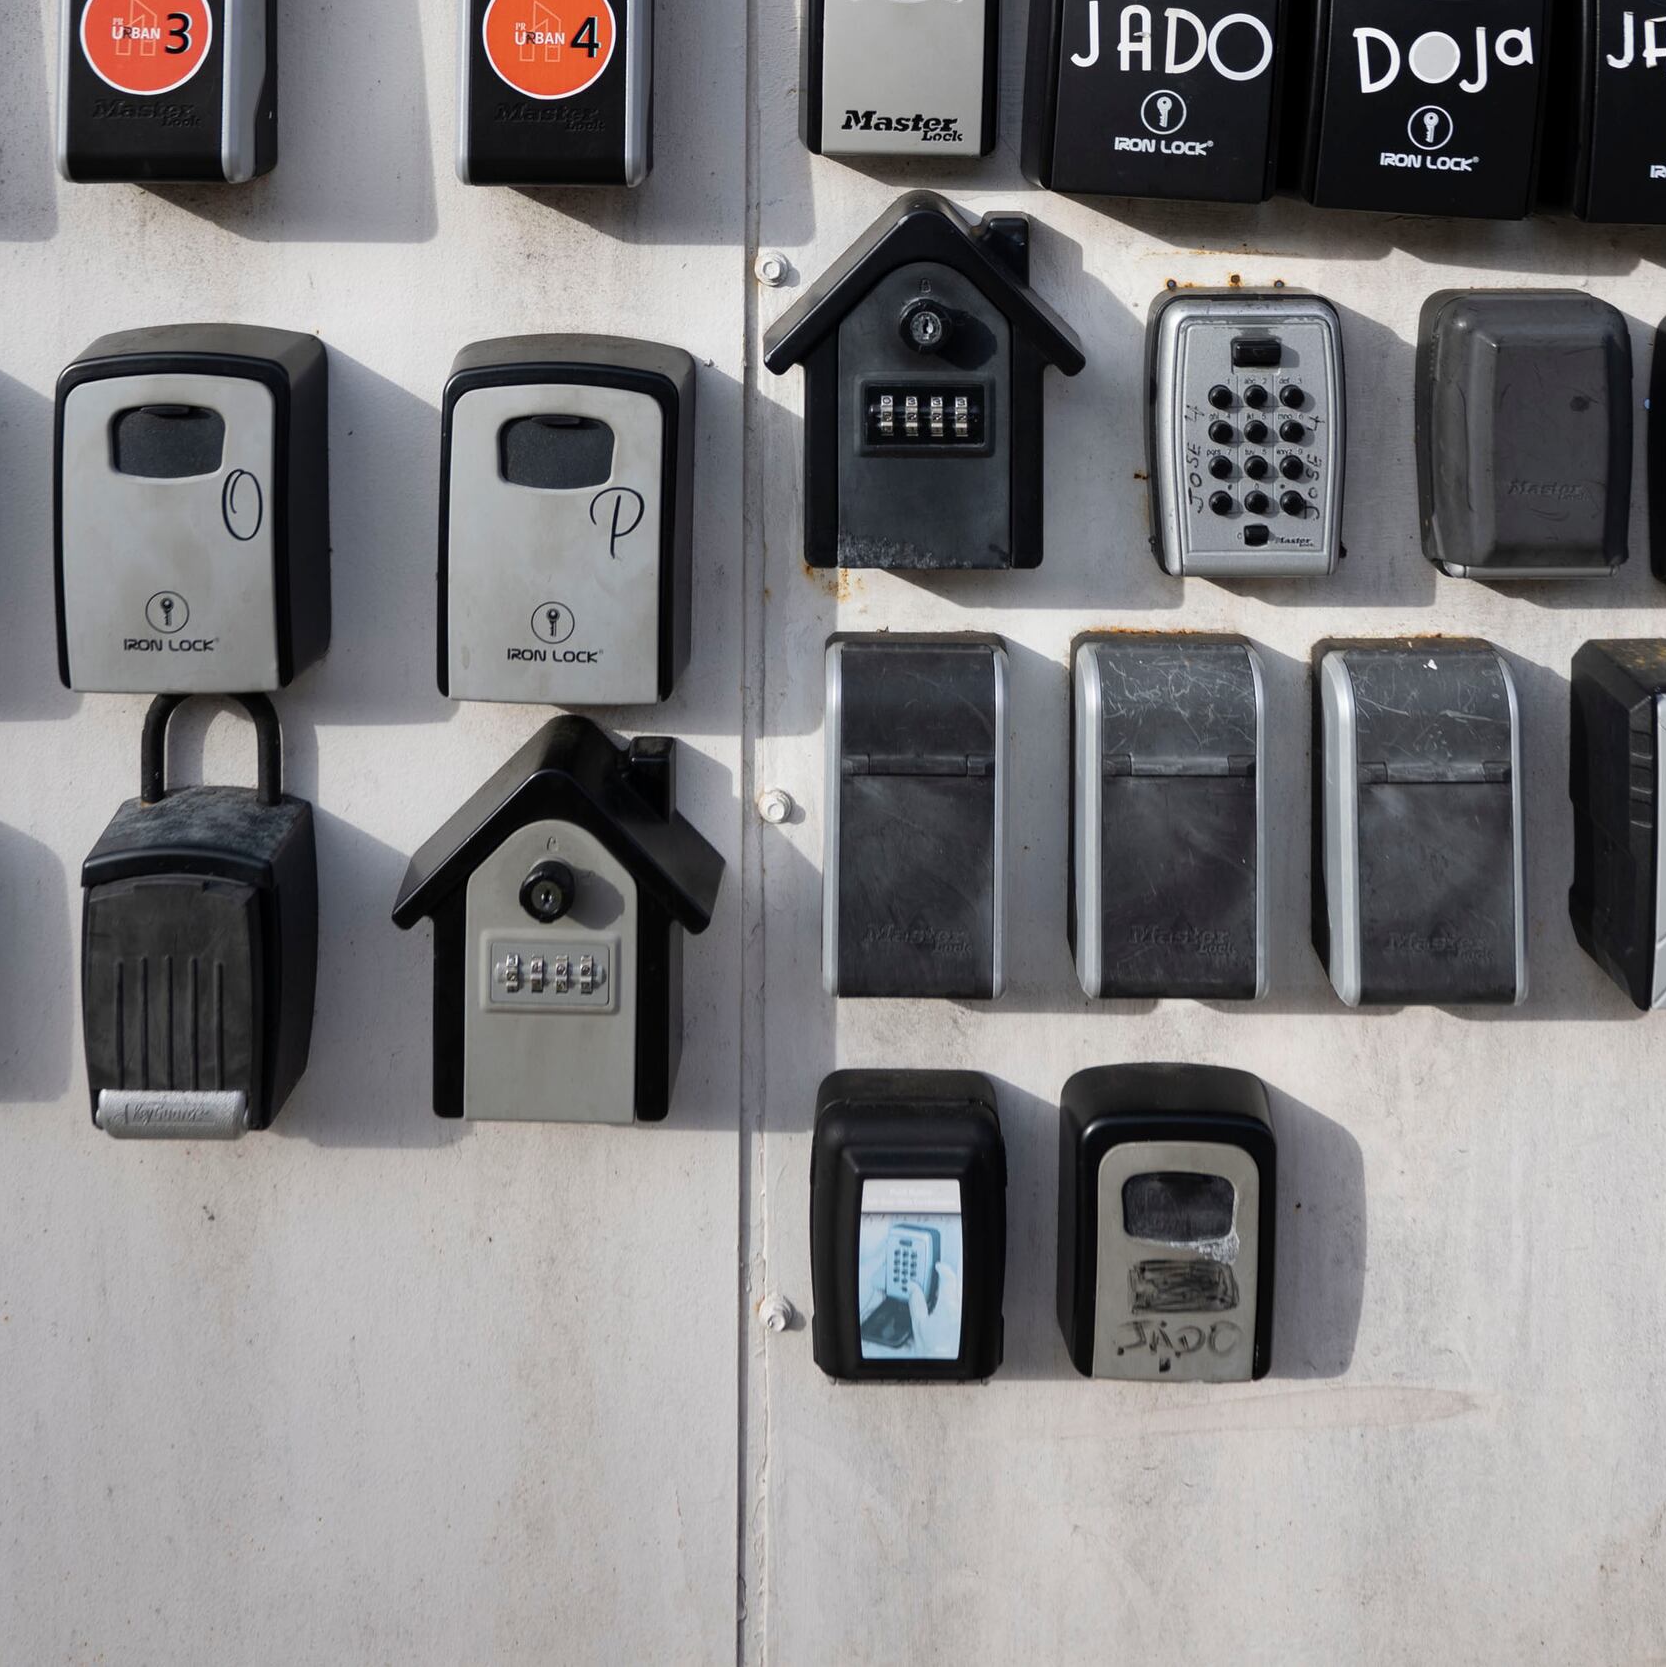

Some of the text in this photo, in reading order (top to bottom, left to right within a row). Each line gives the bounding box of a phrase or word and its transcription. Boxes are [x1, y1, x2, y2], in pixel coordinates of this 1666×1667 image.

[113, 17, 124, 25] PR
[515, 22, 526, 30] PR
[111, 26, 161, 40] URBAN
[164, 11, 193, 54] 3
[514, 31, 566, 45] URBAN
[570, 16, 602, 59] 4
[1070, 0, 1273, 82] JADO
[92, 98, 194, 119] Master
[494, 103, 599, 122] Master
[841, 109, 958, 135] Master
[921, 129, 964, 142] Lock
[1114, 136, 1207, 156] IRON LOCK
[1380, 152, 1472, 172] IRON LOCK
[589, 487, 645, 559] P
[124, 638, 214, 652] IRON LOCK
[507, 648, 598, 663] IRON LOCK
[862, 924, 966, 944] Master
[1130, 925, 1230, 944] Master
